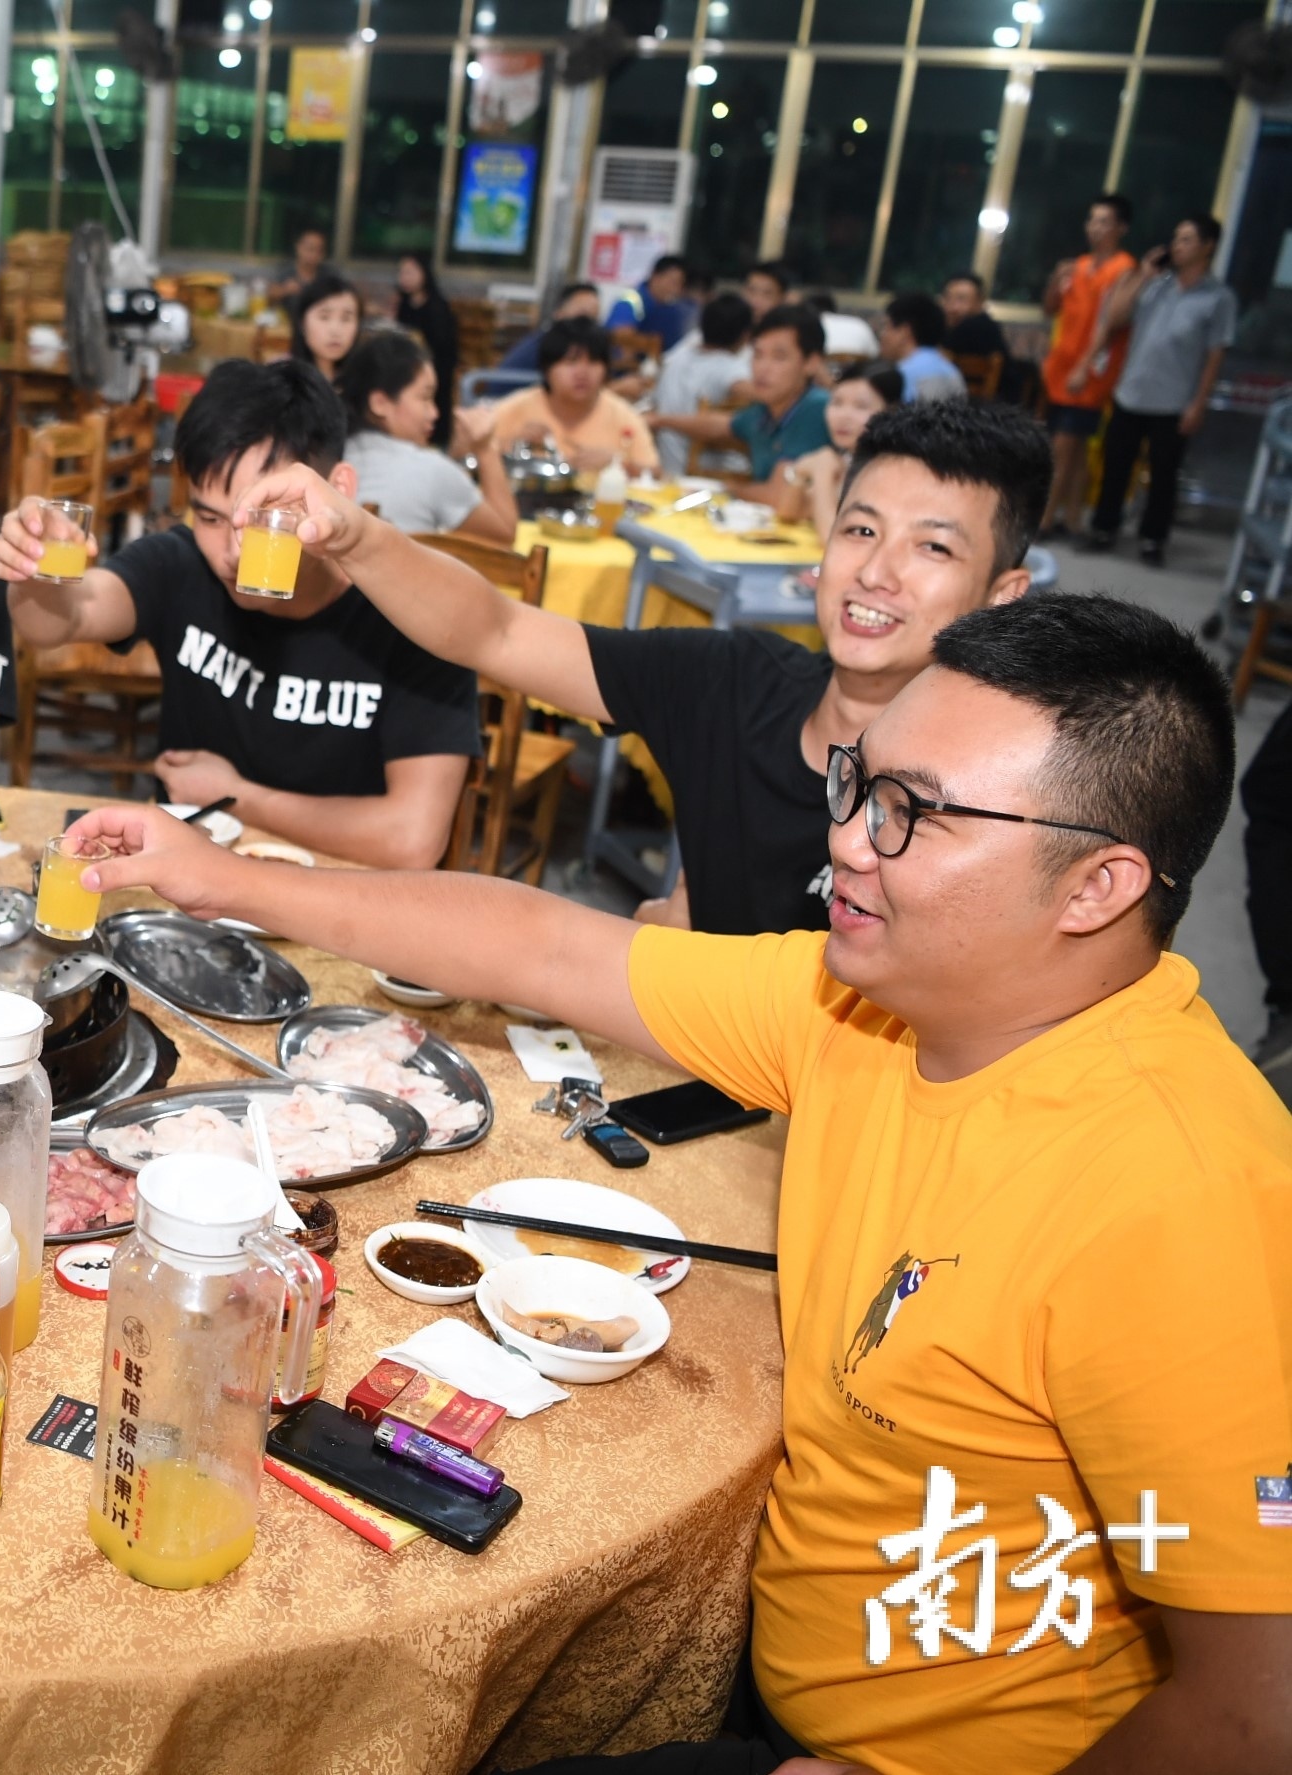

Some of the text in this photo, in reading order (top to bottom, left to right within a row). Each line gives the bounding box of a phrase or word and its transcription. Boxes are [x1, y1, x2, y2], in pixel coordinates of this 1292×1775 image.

[273, 674, 382, 729] BLUE
[846, 1391, 897, 1433] SPORT
[111, 1357, 143, 1530] 鲜榨缤纷果汁
